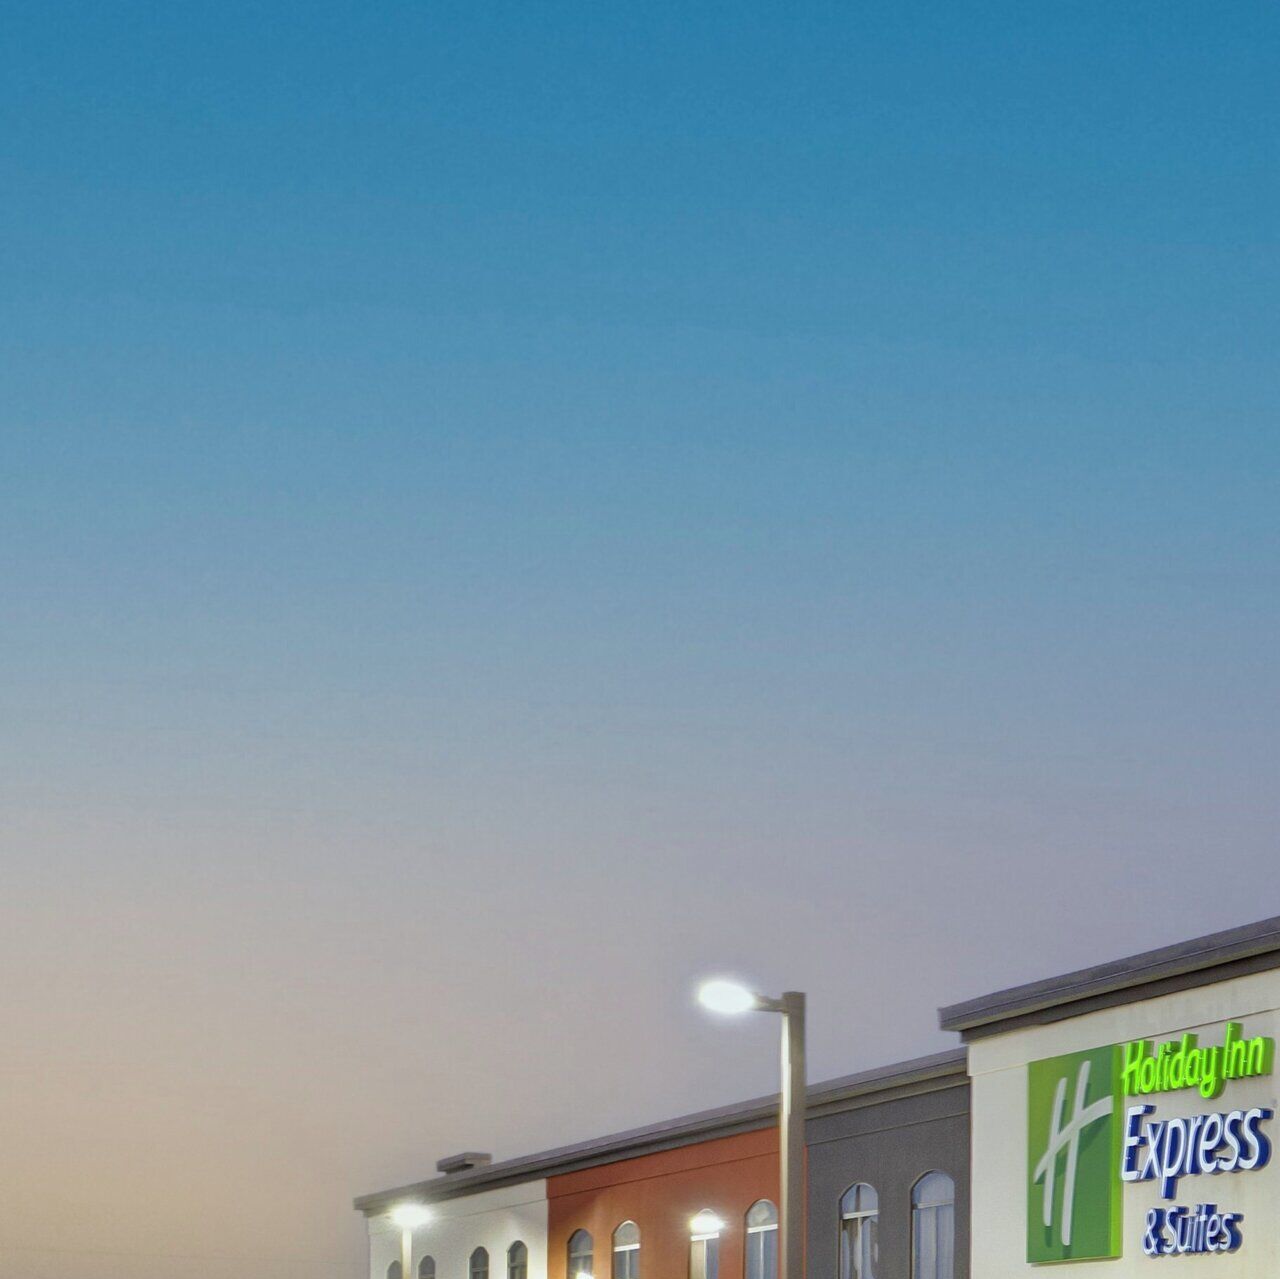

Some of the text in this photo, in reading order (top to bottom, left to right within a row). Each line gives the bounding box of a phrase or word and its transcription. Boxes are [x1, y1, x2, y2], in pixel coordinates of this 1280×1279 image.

[1121, 1022, 1275, 1099] Holiday Inn
[1121, 1104, 1275, 1200] Express
[1142, 1203, 1244, 1256] & Suites
